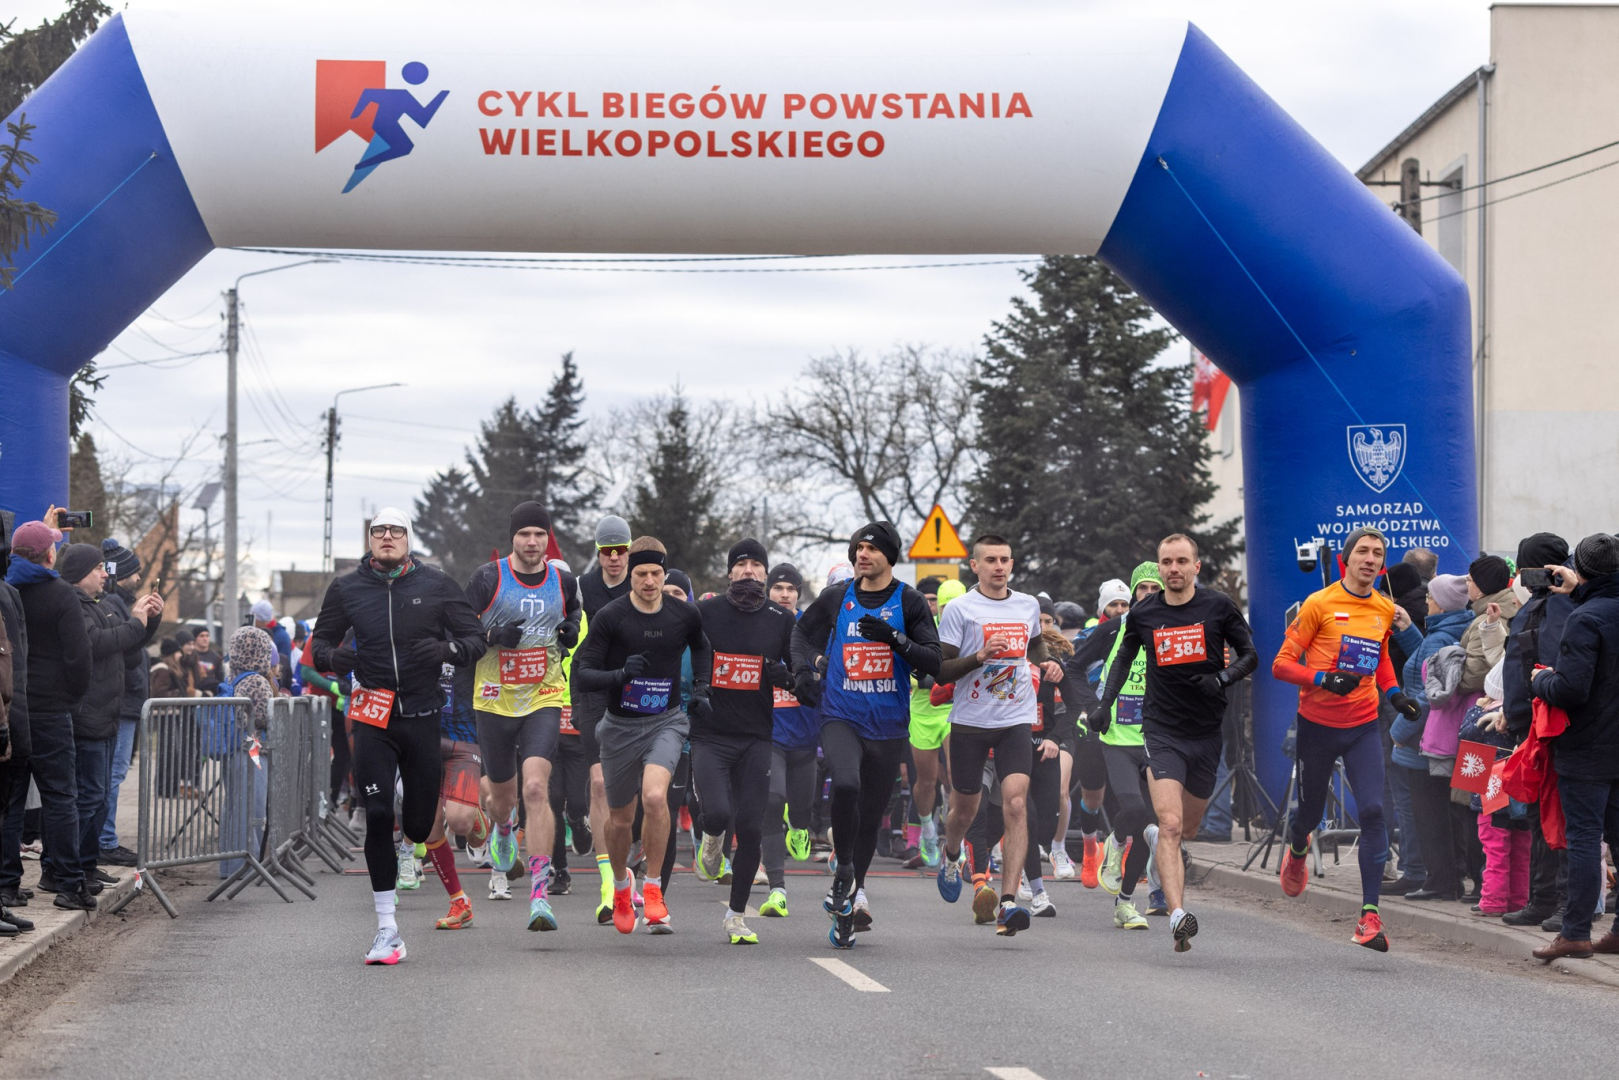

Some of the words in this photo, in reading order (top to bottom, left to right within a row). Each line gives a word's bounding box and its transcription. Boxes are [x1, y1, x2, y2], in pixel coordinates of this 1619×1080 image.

[477, 90, 588, 118] CYKL
[601, 85, 768, 120] BIEGÓW
[783, 92, 1033, 119] POWSTANIA
[478, 128, 886, 158] WIELKOPOLSKIEGO
[1336, 502, 1423, 517] SAMORZĄD
[644, 630, 663, 639] RUN
[1173, 641, 1205, 658] 384
[519, 662, 546, 679] 335
[862, 658, 892, 673] 427
[730, 669, 760, 684] 402
[640, 694, 669, 708] 096
[362, 702, 390, 721] 457
